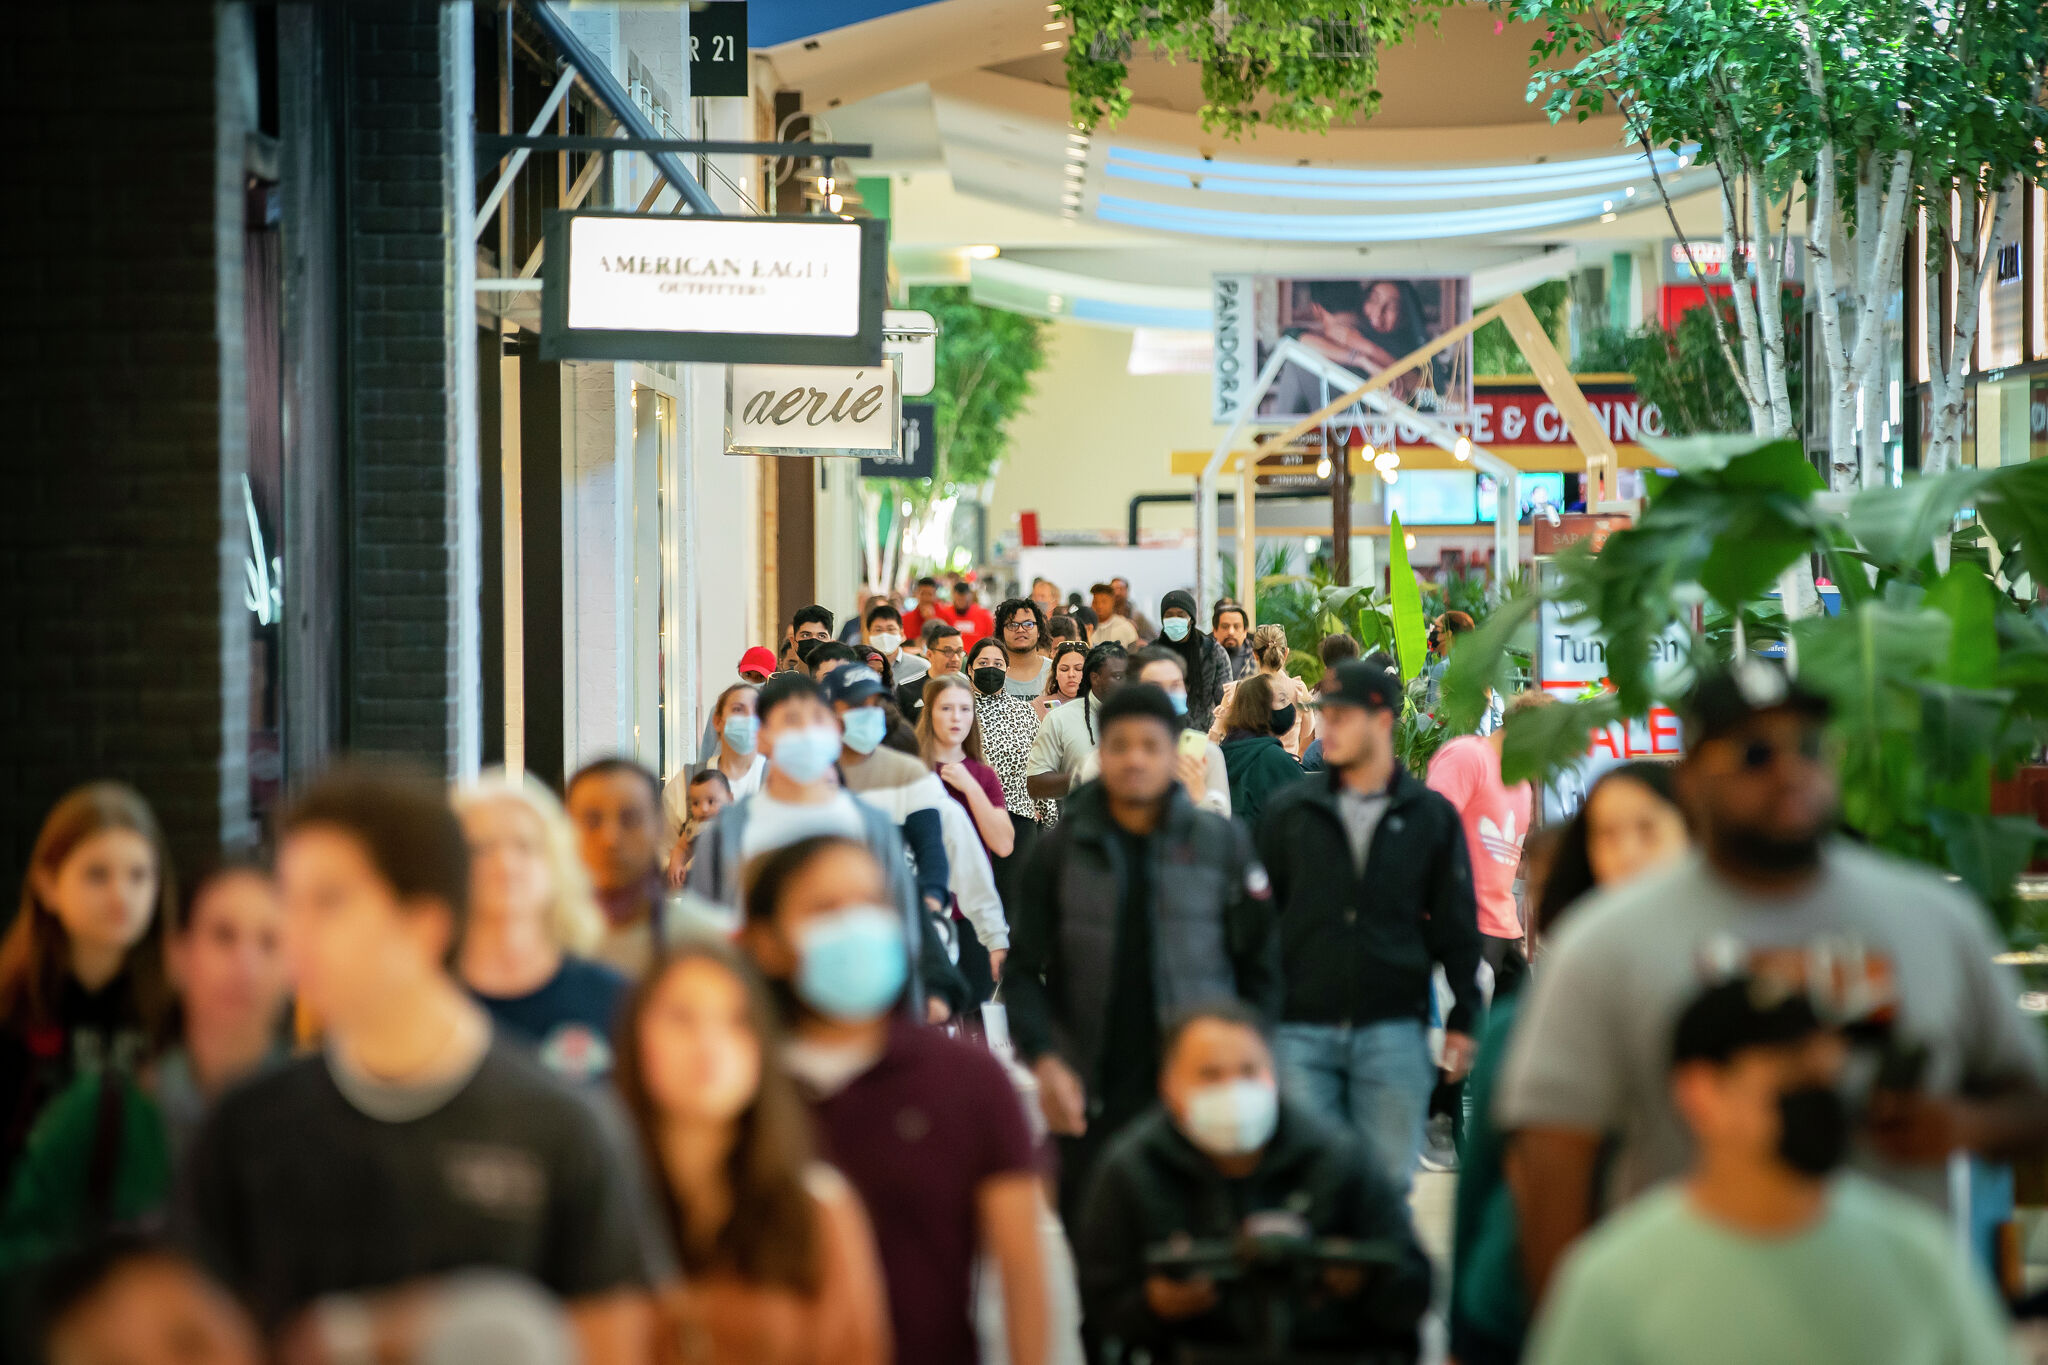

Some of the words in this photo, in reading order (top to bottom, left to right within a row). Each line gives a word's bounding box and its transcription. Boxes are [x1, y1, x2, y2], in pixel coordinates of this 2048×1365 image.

[712, 35, 734, 61] 21
[599, 255, 741, 277] AMERICAN
[1218, 279, 1240, 416] PANDORA
[742, 370, 884, 427] aerie
[1502, 406, 1526, 440] &
[1533, 402, 1666, 444] CNNO
[1555, 634, 1679, 663] Tunen
[1587, 706, 1680, 759] ALE
